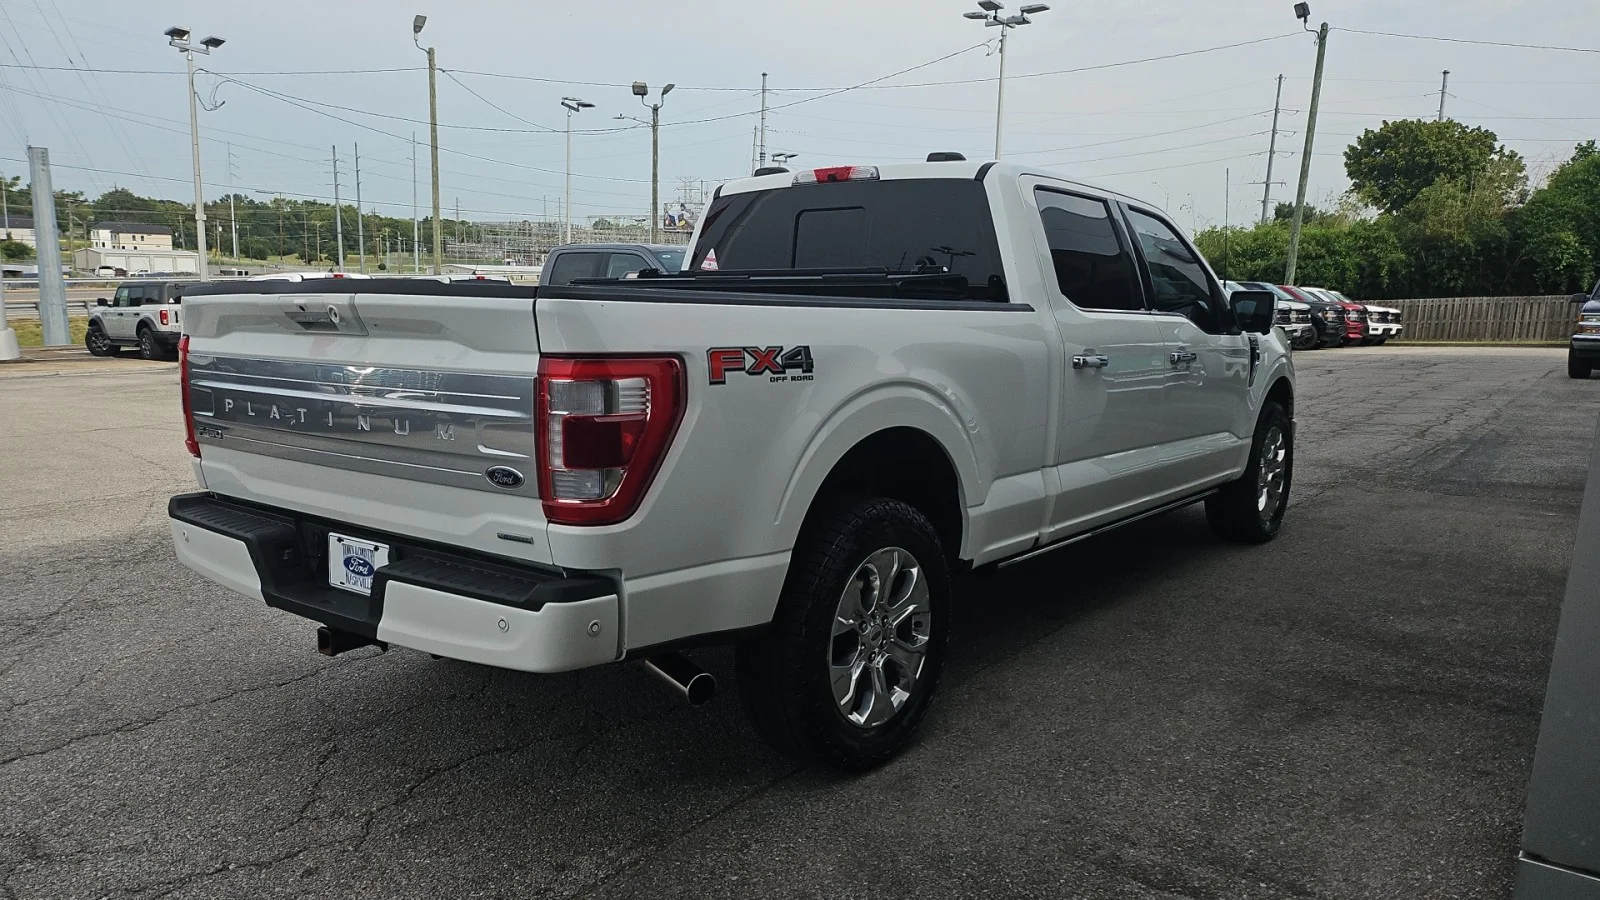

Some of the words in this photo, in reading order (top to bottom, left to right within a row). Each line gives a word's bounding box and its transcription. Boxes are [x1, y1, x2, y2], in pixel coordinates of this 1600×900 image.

[706, 345, 814, 385] FX4
[225, 398, 455, 440] PLATINUM
[348, 557, 369, 575] Ford
